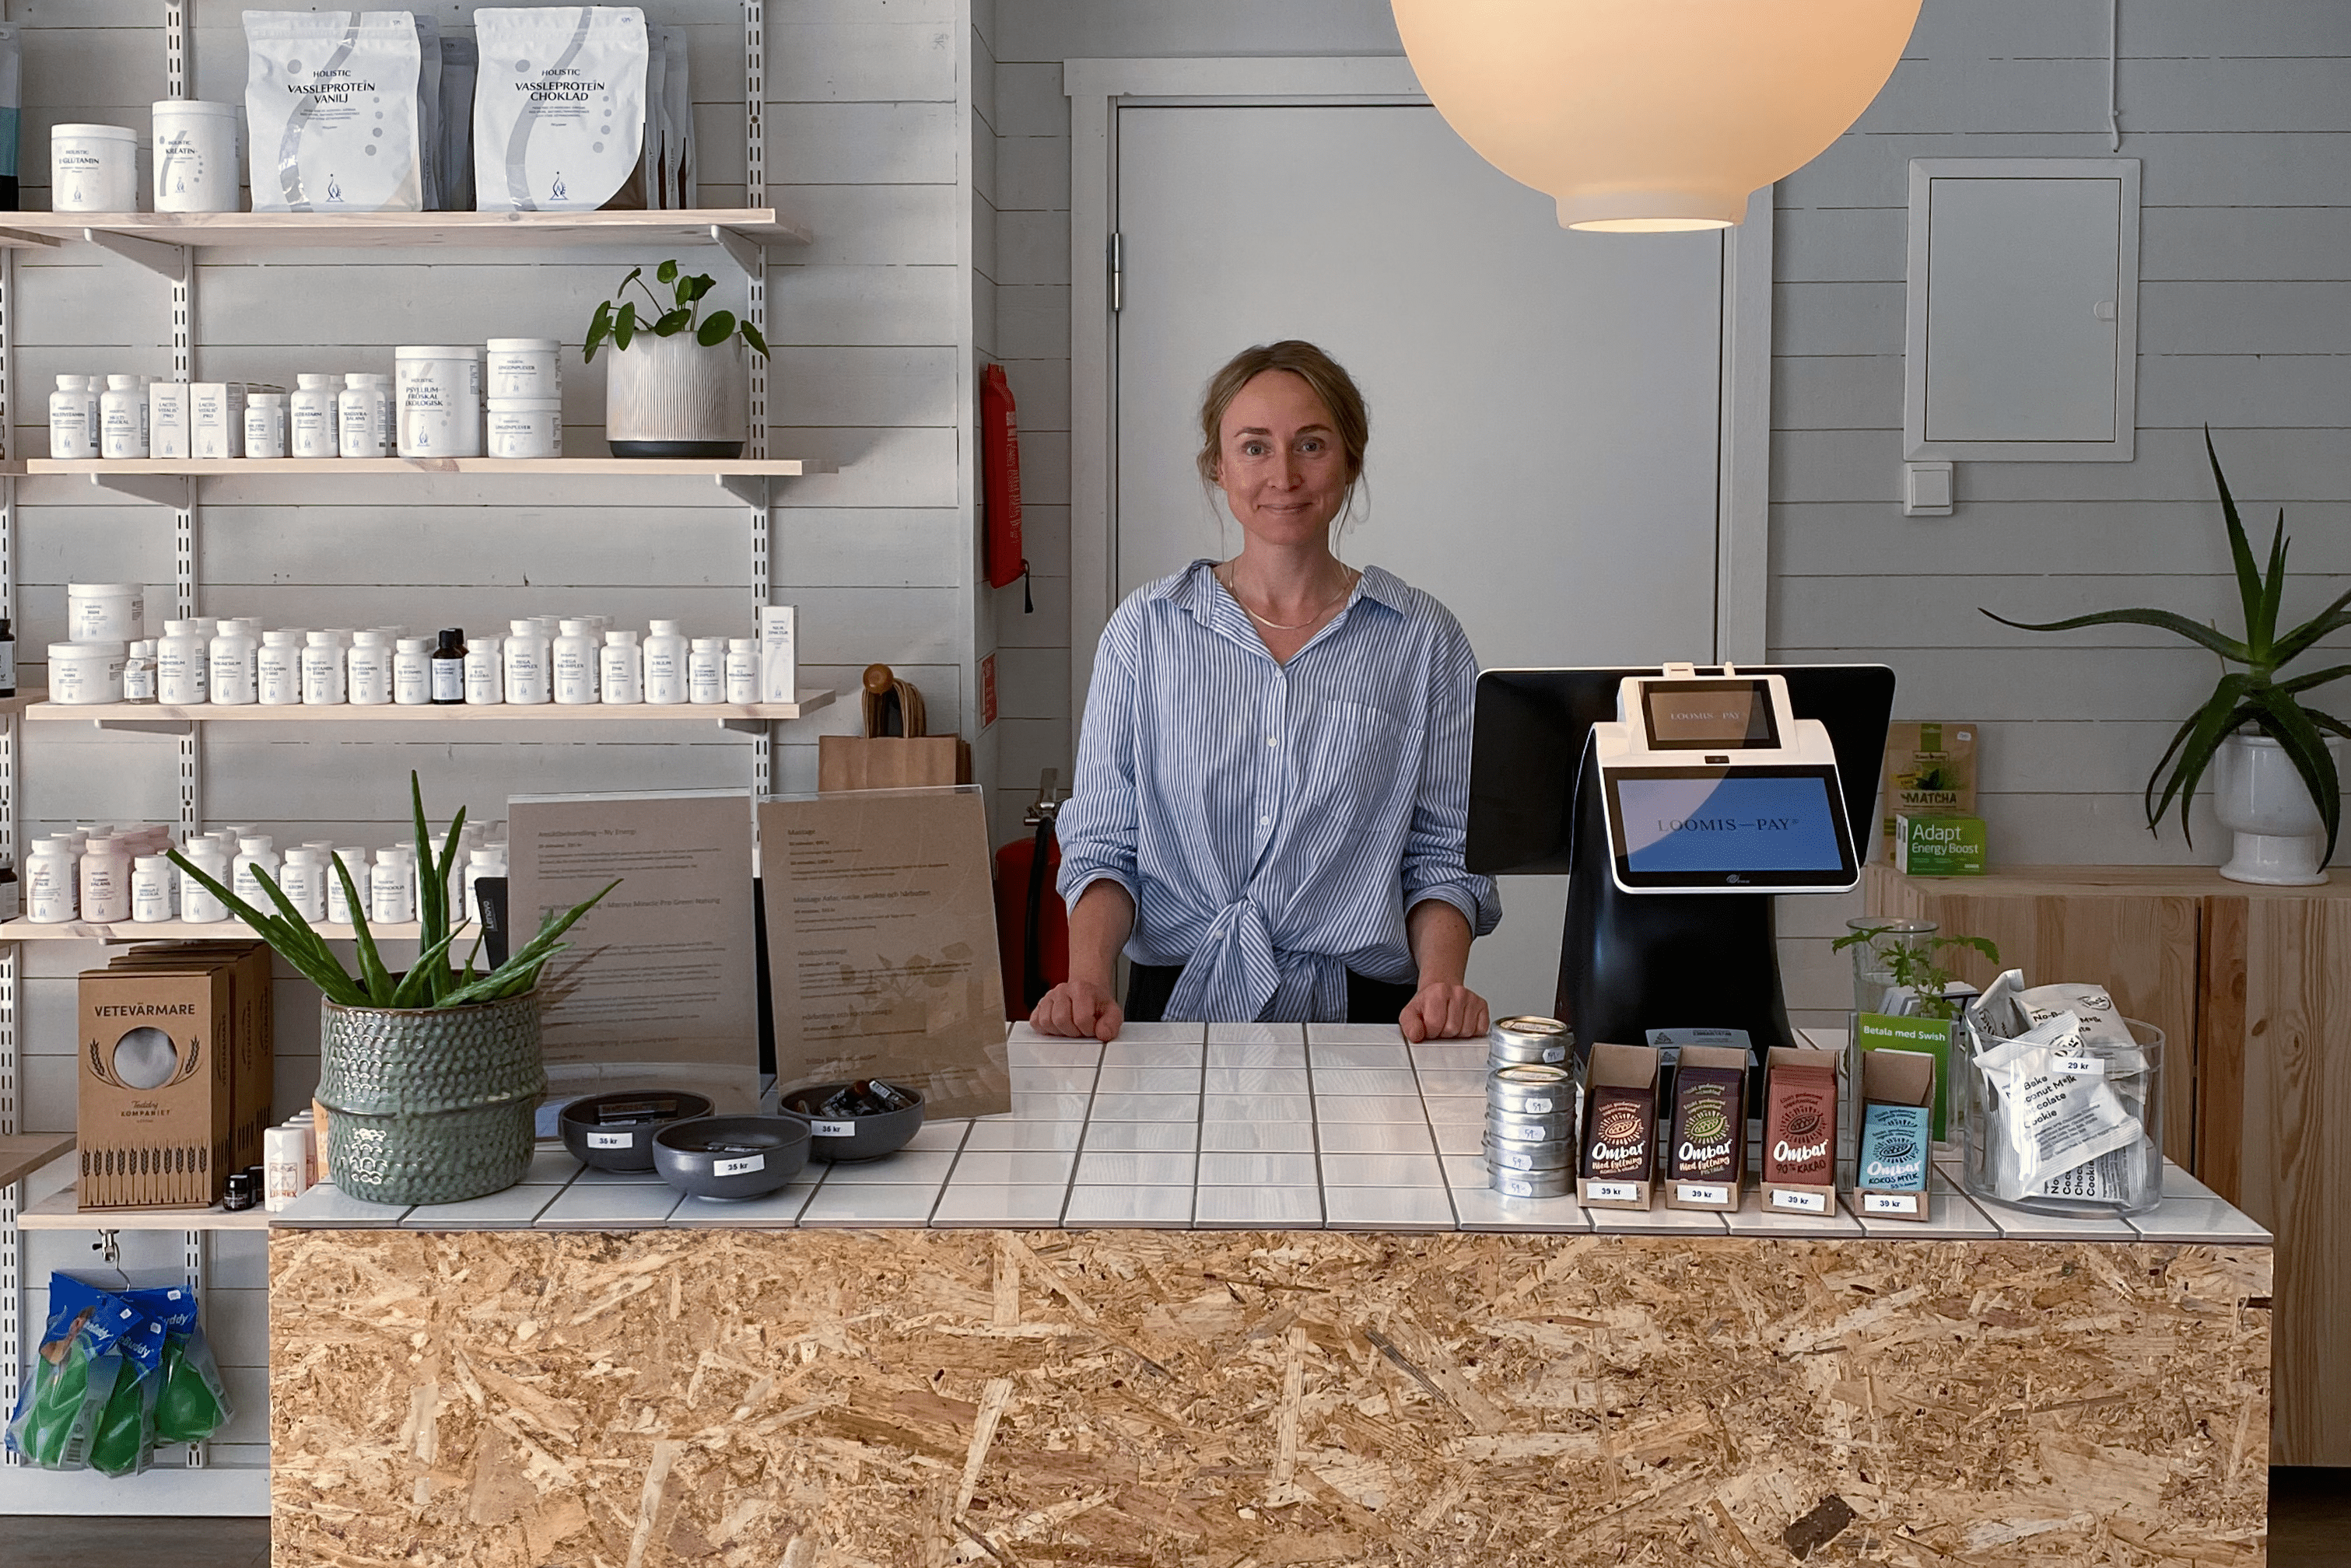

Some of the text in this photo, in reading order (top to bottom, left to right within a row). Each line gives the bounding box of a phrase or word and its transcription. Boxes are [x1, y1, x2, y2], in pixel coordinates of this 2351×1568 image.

[313, 69, 351, 78] HOLISTIC
[287, 79, 375, 94] VASSLEPROTEIN
[515, 79, 604, 91] VASSLEPROTEIN
[314, 93, 348, 103] VANILJ
[530, 92, 589, 101] CHOKLAD
[1722, 712, 1741, 720] PAY
[1906, 792, 1957, 804] MATCHA
[1912, 824, 1962, 843] Adapt
[1911, 842, 1978, 856] Energy Boost
[483, 900, 494, 929] Lenovo
[95, 1002, 196, 1017] VETEVÄRMARE
[1863, 1025, 1892, 1036] Betala
[1918, 1031, 1946, 1041] Swish
[131, 1100, 159, 1111] Teddy
[121, 1109, 171, 1118] KOMPANIET
[1592, 1140, 1645, 1160] Ombar
[1678, 1139, 1733, 1161] Ombar
[1773, 1139, 1828, 1163] Ombar
[1592, 1157, 1642, 1171] Med fyllning
[1698, 1157, 1730, 1171] fyllning
[1775, 1164, 1789, 1174] 90
[1797, 1159, 1827, 1173] KAKAO
[1867, 1160, 1922, 1176] Ombar
[1868, 1176, 1896, 1185] KOKOS
